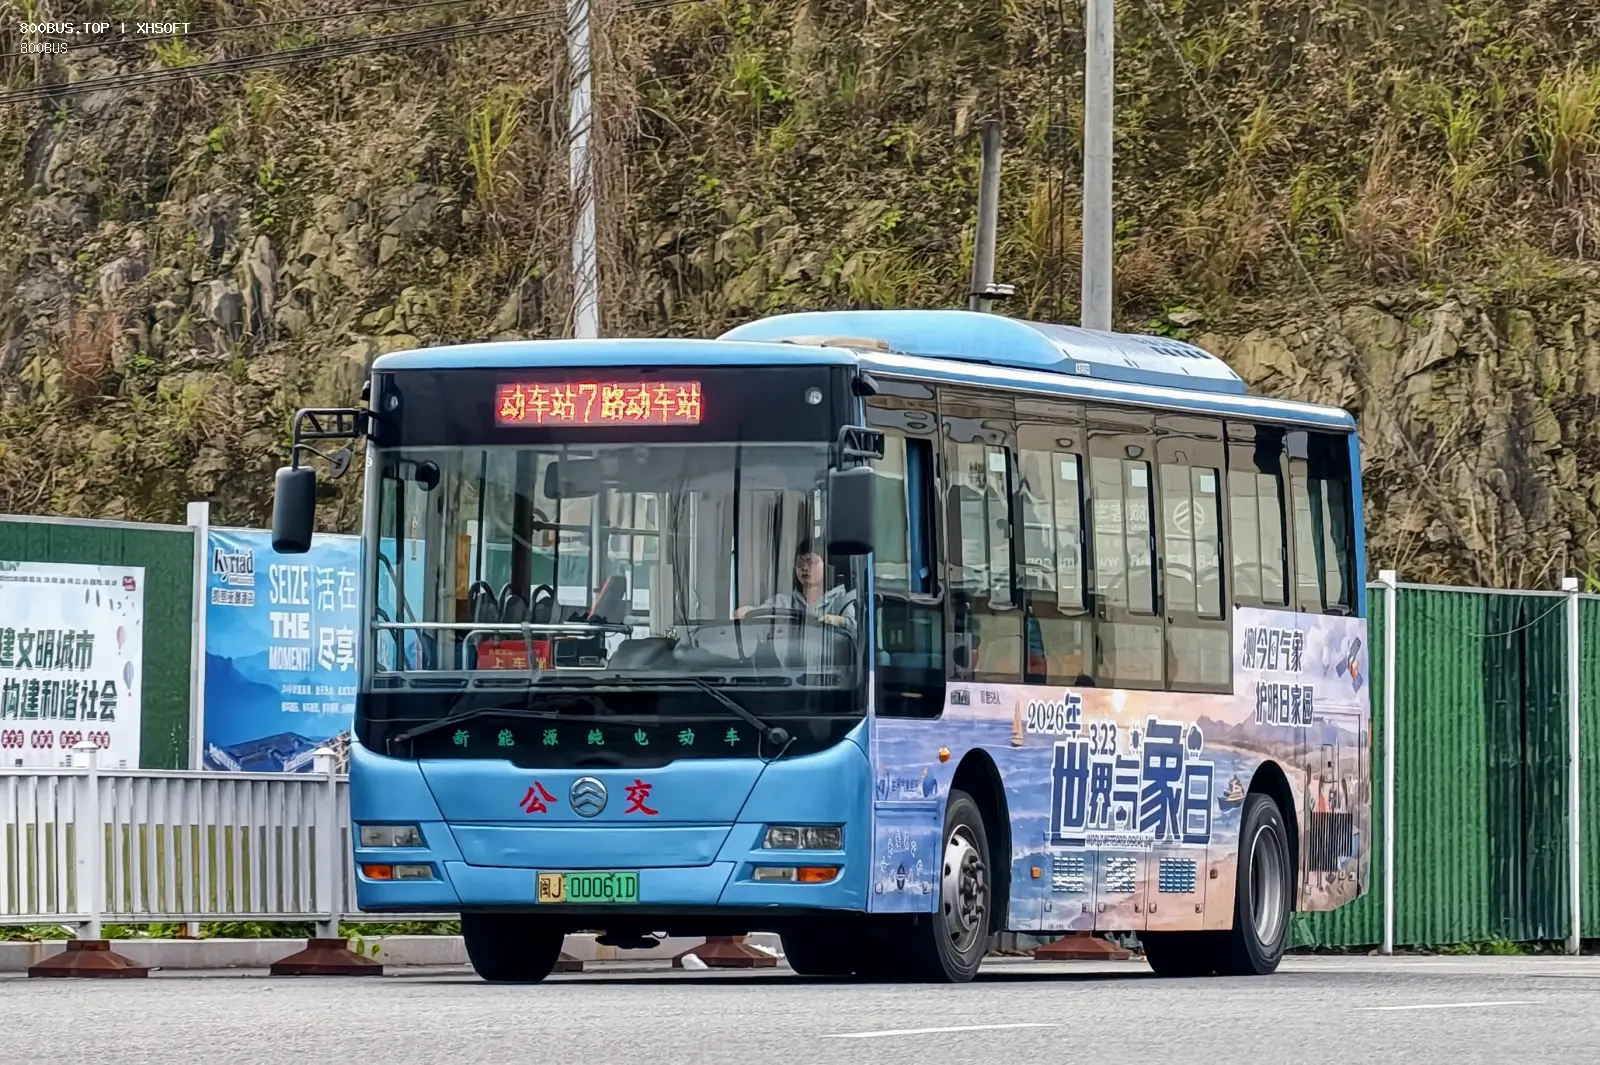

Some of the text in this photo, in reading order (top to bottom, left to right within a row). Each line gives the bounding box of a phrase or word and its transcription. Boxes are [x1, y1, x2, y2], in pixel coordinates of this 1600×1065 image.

[499, 383, 700, 424] 动车站7路动车站
[213, 549, 254, 581] Kyriad
[269, 564, 310, 605] SEIZE
[316, 566, 357, 611] 活在
[269, 611, 310, 639] THE
[269, 646, 311, 671] MOMENT!
[318, 625, 359, 672] 尽享
[2, 677, 117, 721] 构建和谐社会
[1028, 693, 1081, 739] 2026年
[1256, 681, 1314, 725] 护明日家园
[452, 729, 741, 748] 新能源纯电动车
[1089, 723, 1117, 756] 3.23
[1050, 719, 1214, 846] 世界气象日
